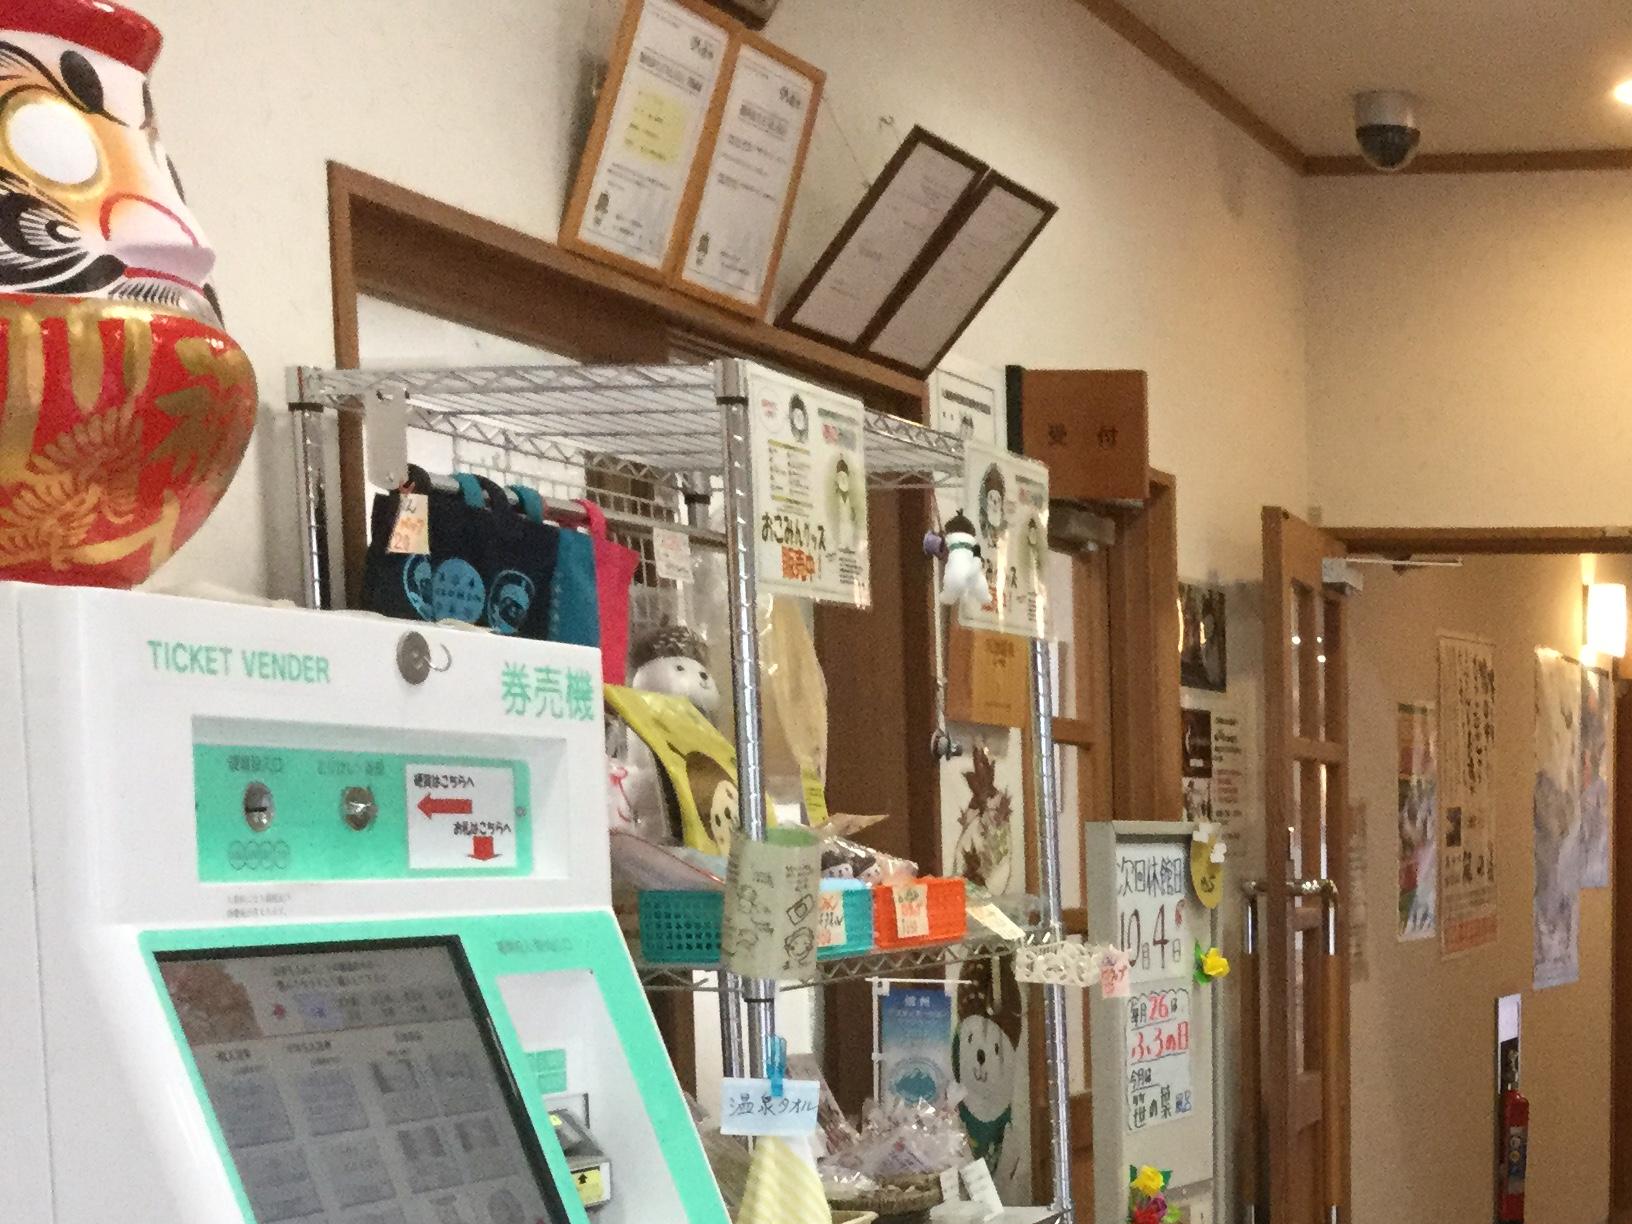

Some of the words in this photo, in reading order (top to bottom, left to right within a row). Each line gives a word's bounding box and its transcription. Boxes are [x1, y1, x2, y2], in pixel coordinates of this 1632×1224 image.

[147, 640, 233, 677] TICKET
[243, 649, 331, 684] VENDER
[501, 660, 595, 722] 券売機
[413, 772, 475, 789] 硬貨はこちらへ
[728, 1091, 818, 1118] 温泉タオル
